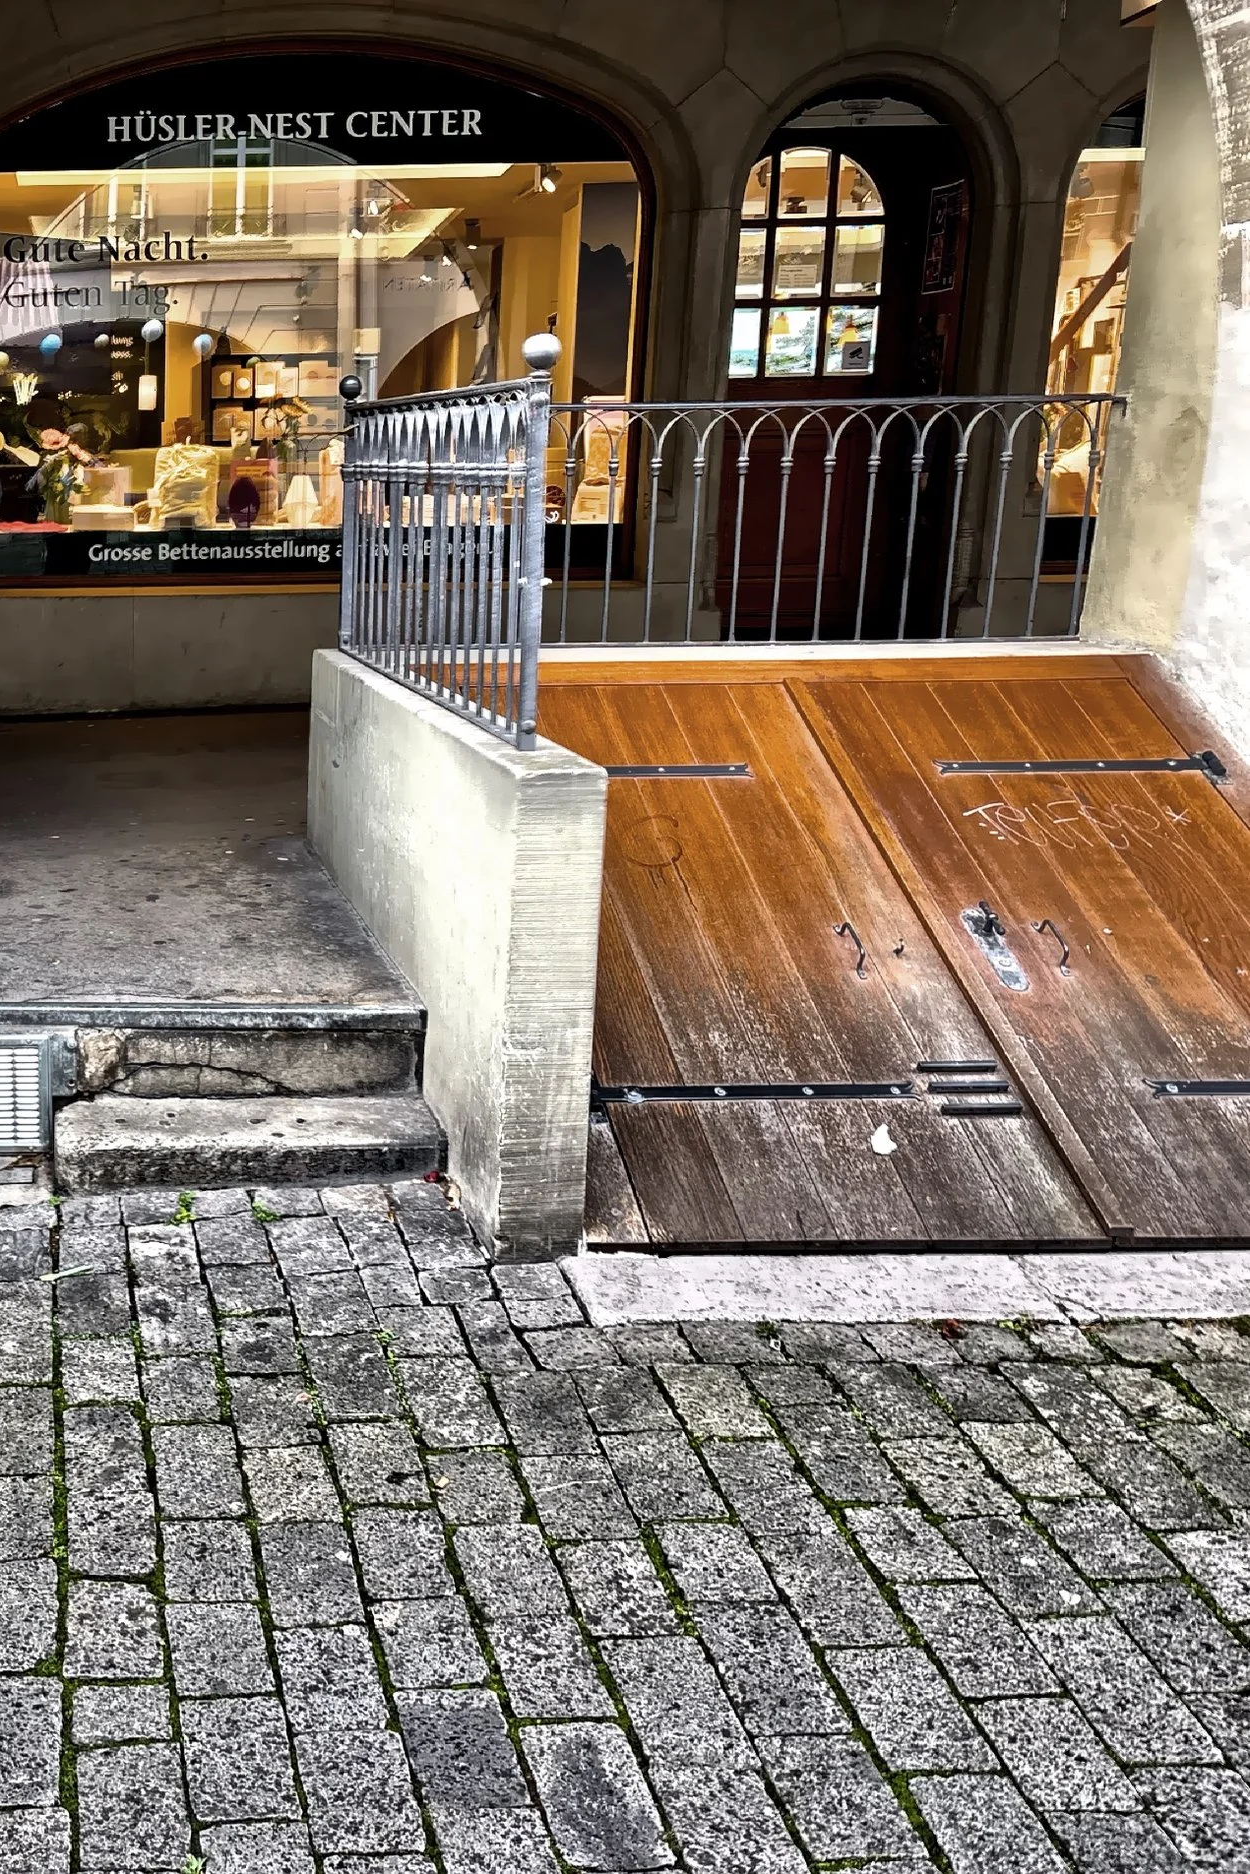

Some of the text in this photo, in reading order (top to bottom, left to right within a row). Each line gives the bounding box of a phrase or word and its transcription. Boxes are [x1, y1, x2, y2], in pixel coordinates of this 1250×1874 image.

[106, 108, 483, 142] HÜSLER NEST CENTER
[3, 231, 209, 264] Gute Nacht.
[4, 280, 179, 316] Guten Tag.
[88, 543, 153, 562] Grosse
[157, 540, 331, 564] Bettenausstellung
